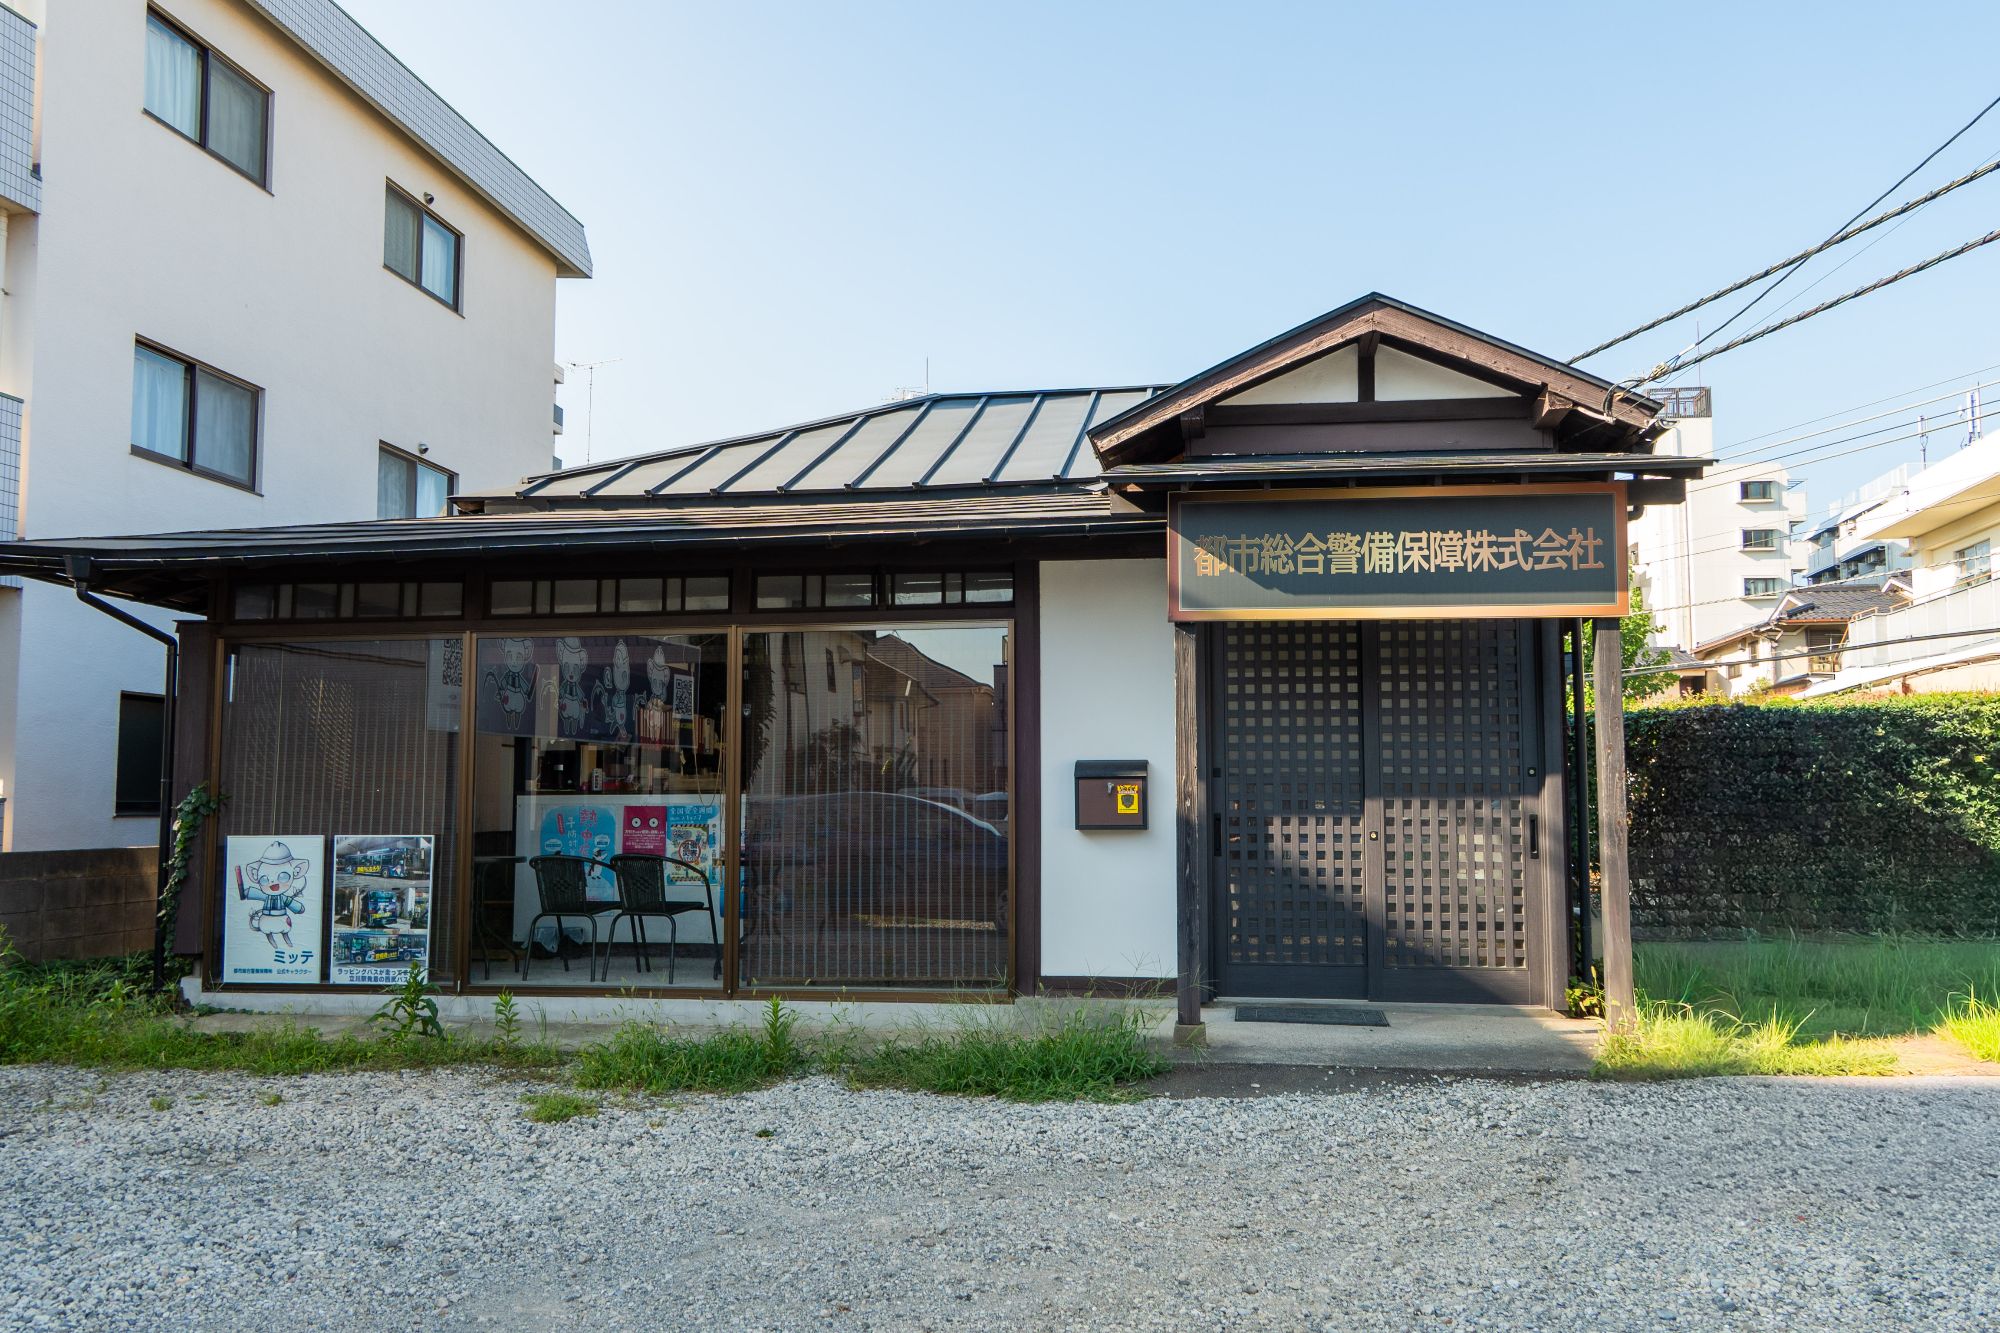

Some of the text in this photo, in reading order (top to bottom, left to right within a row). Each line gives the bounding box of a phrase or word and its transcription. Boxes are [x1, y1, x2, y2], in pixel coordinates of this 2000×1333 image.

[1193, 527, 1605, 577] 都市総合警備保障株式会社
[273, 950, 314, 964] ミッテ
[337, 968, 412, 976] ラッピングバスが走ってま
